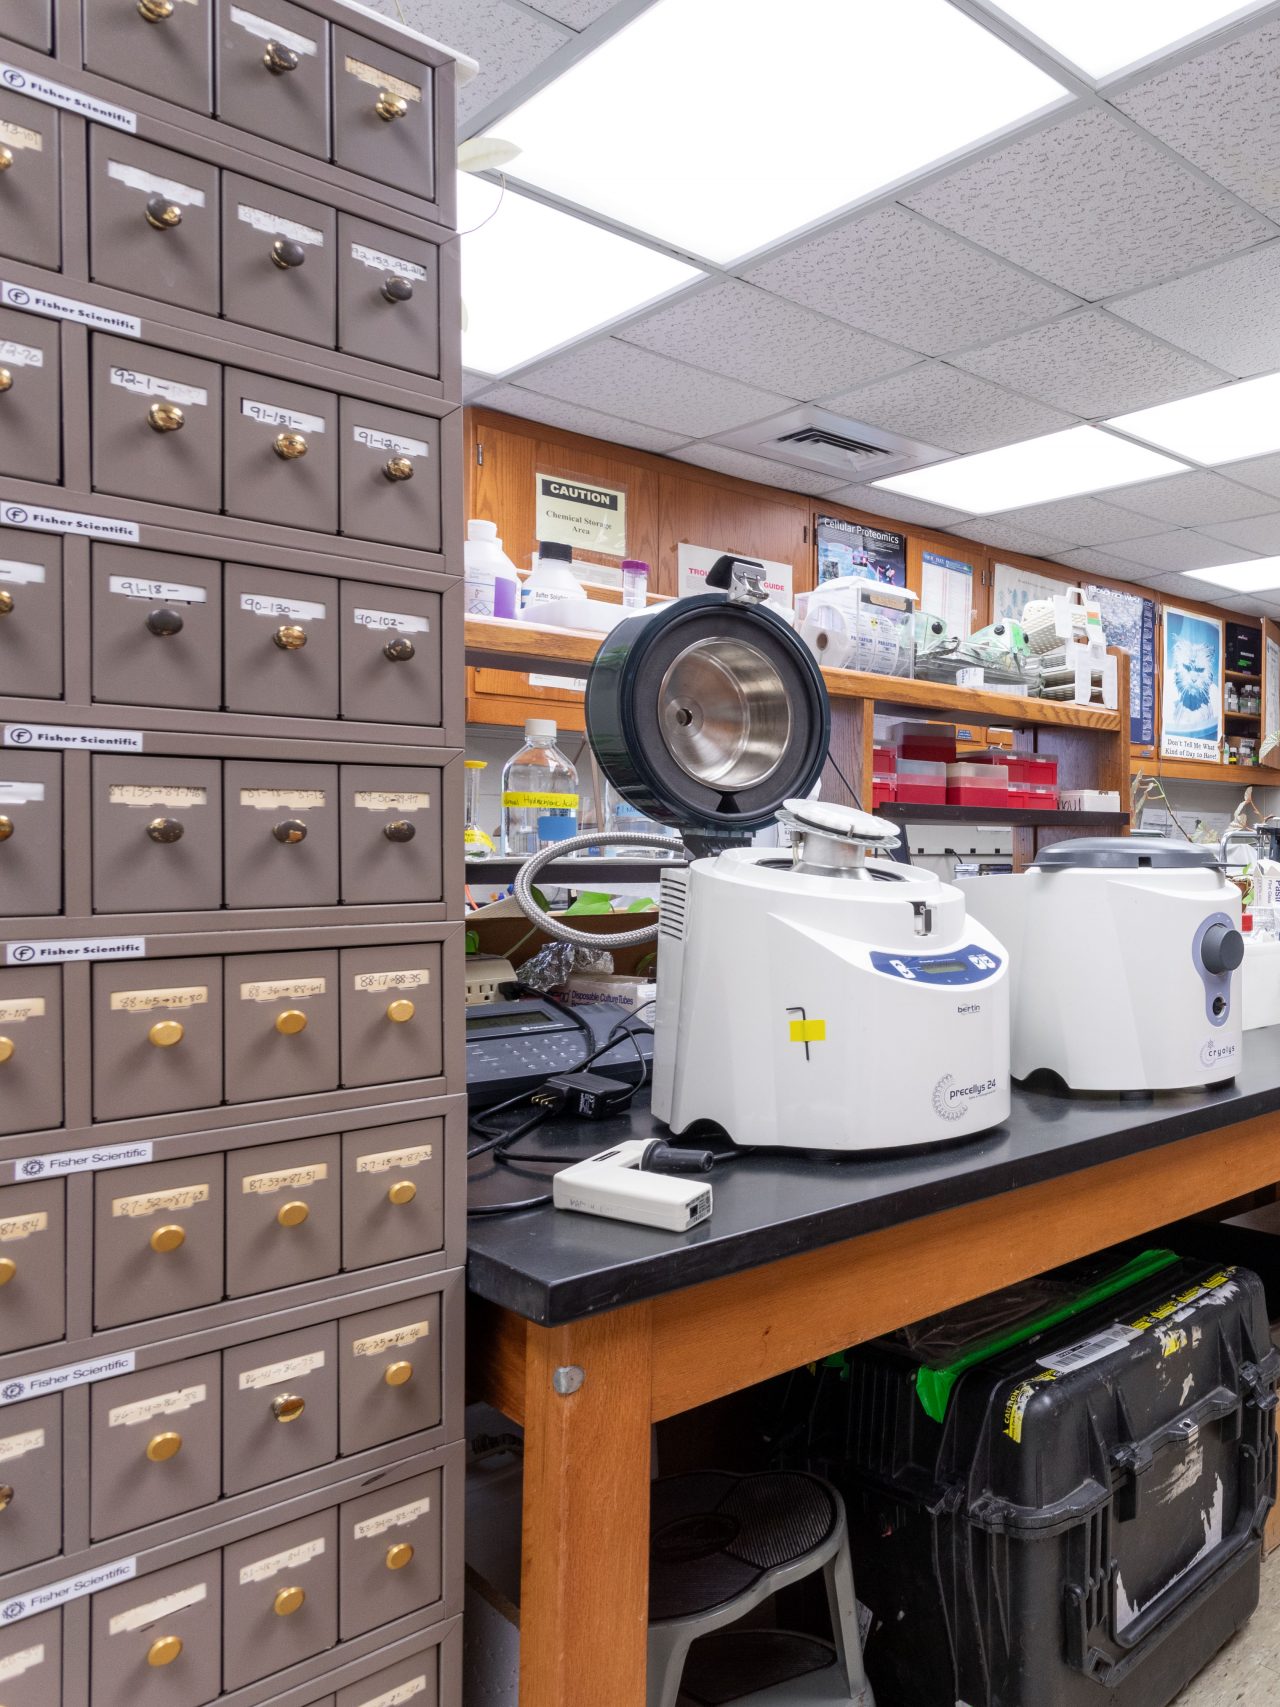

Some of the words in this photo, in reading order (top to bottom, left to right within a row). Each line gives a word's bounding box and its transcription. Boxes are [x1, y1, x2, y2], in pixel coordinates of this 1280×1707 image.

[31, 82, 71, 102] Fisher
[74, 98, 132, 126] Scientific
[35, 297, 75, 316] Fisher
[77, 308, 135, 331] Scientific
[550, 483, 610, 505] CAUTION
[33, 513, 73, 527] Fisher
[76, 520, 135, 536] Scientific
[546, 510, 582, 523] Chemical
[584, 518, 612, 530] Storage
[572, 526, 590, 535] Area
[824, 518, 856, 533] Cellular
[856, 525, 899, 544] Proteomics
[763, 581, 785, 592] GUIDE
[37, 732, 78, 743] Fisher
[80, 734, 139, 746] Scientific
[1167, 738, 1182, 747] Don't
[40, 946, 81, 957] Fisher
[83, 943, 141, 954] Scientific
[571, 991, 599, 1002] Disposable
[600, 992, 618, 1004] Culture
[618, 995, 634, 1005] Tubes
[957, 1004, 981, 1014] bertin
[1208, 1045, 1235, 1057] cryolys
[949, 1084, 986, 1101] precellys
[987, 1078, 997, 1090] 24
[50, 1156, 89, 1169] Fisher
[91, 1147, 148, 1163] Scientific
[30, 1371, 70, 1390] Fisher
[73, 1358, 130, 1378] Scientific
[1003, 1388, 1020, 1425] CAUTION
[30, 1584, 70, 1607] Fisher
[73, 1564, 130, 1595] Scientific
